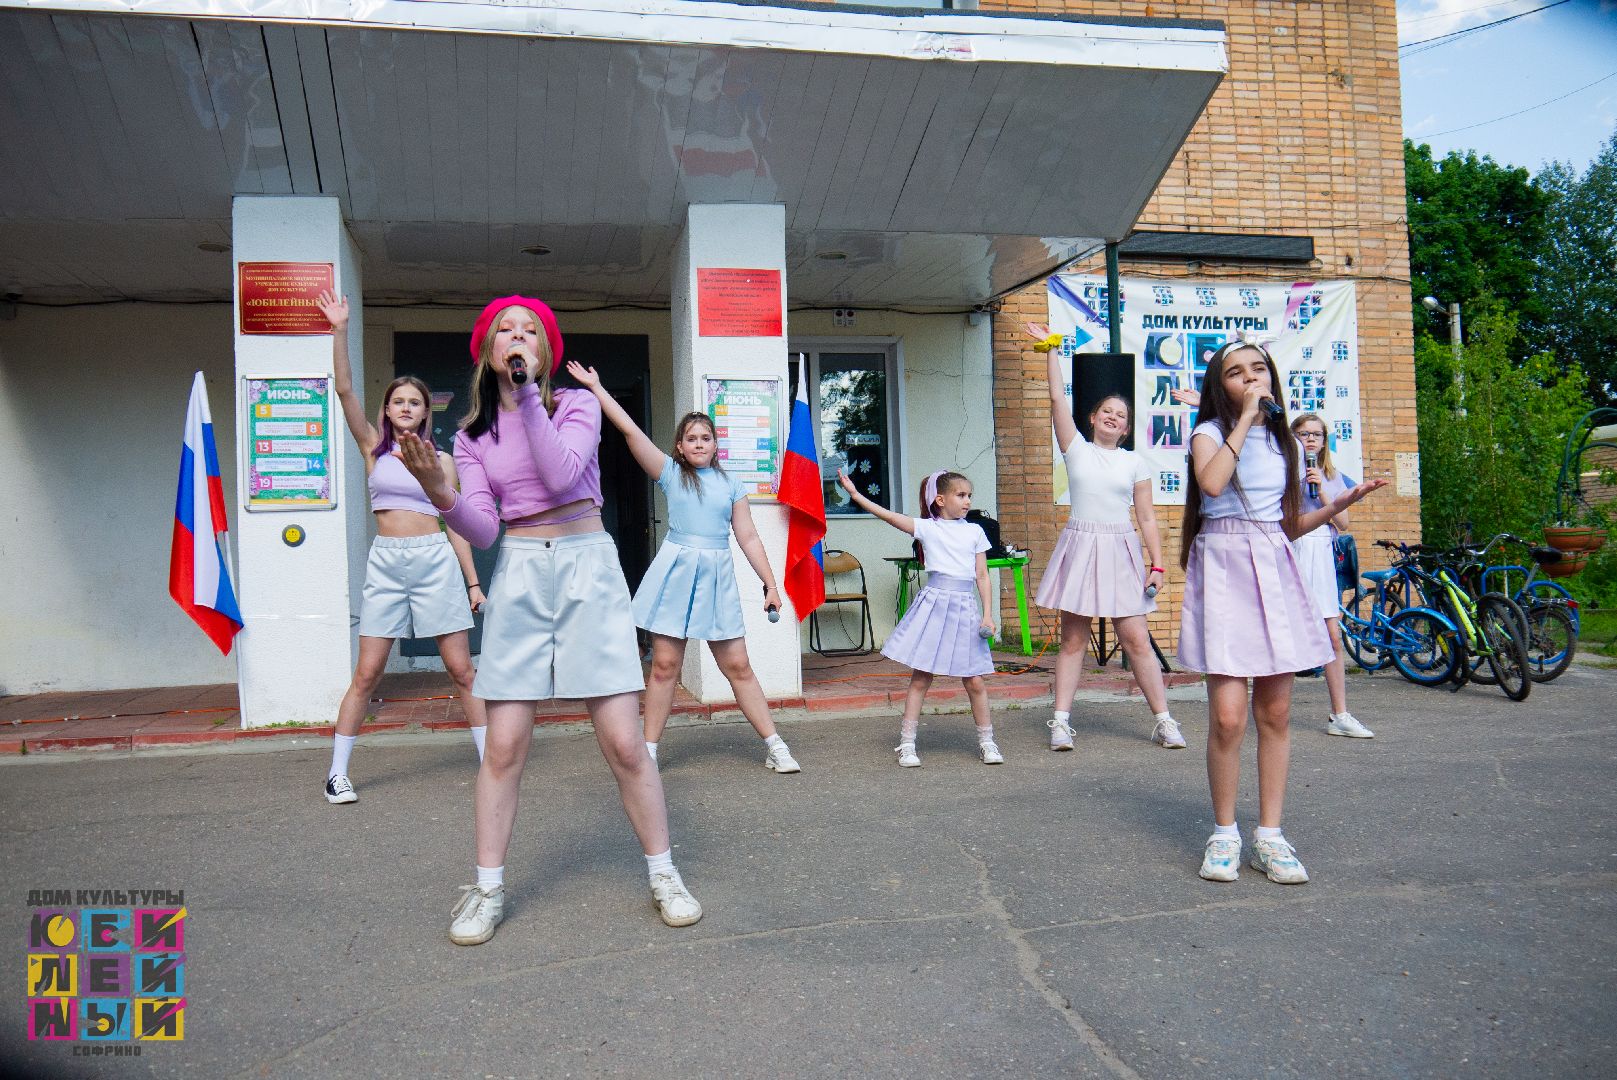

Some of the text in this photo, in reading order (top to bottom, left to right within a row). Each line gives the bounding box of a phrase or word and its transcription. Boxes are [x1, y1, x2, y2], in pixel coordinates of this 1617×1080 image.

[1142, 314, 1178, 329] ДОМ
[1182, 315, 1269, 331] КУЛЬТУРЫ
[267, 389, 311, 400] ИЮНЬ
[724, 396, 762, 405] ИЮНЬ
[260, 406, 268, 415] 5
[258, 442, 269, 452] 13
[307, 460, 321, 469] 14
[258, 478, 271, 488] 19
